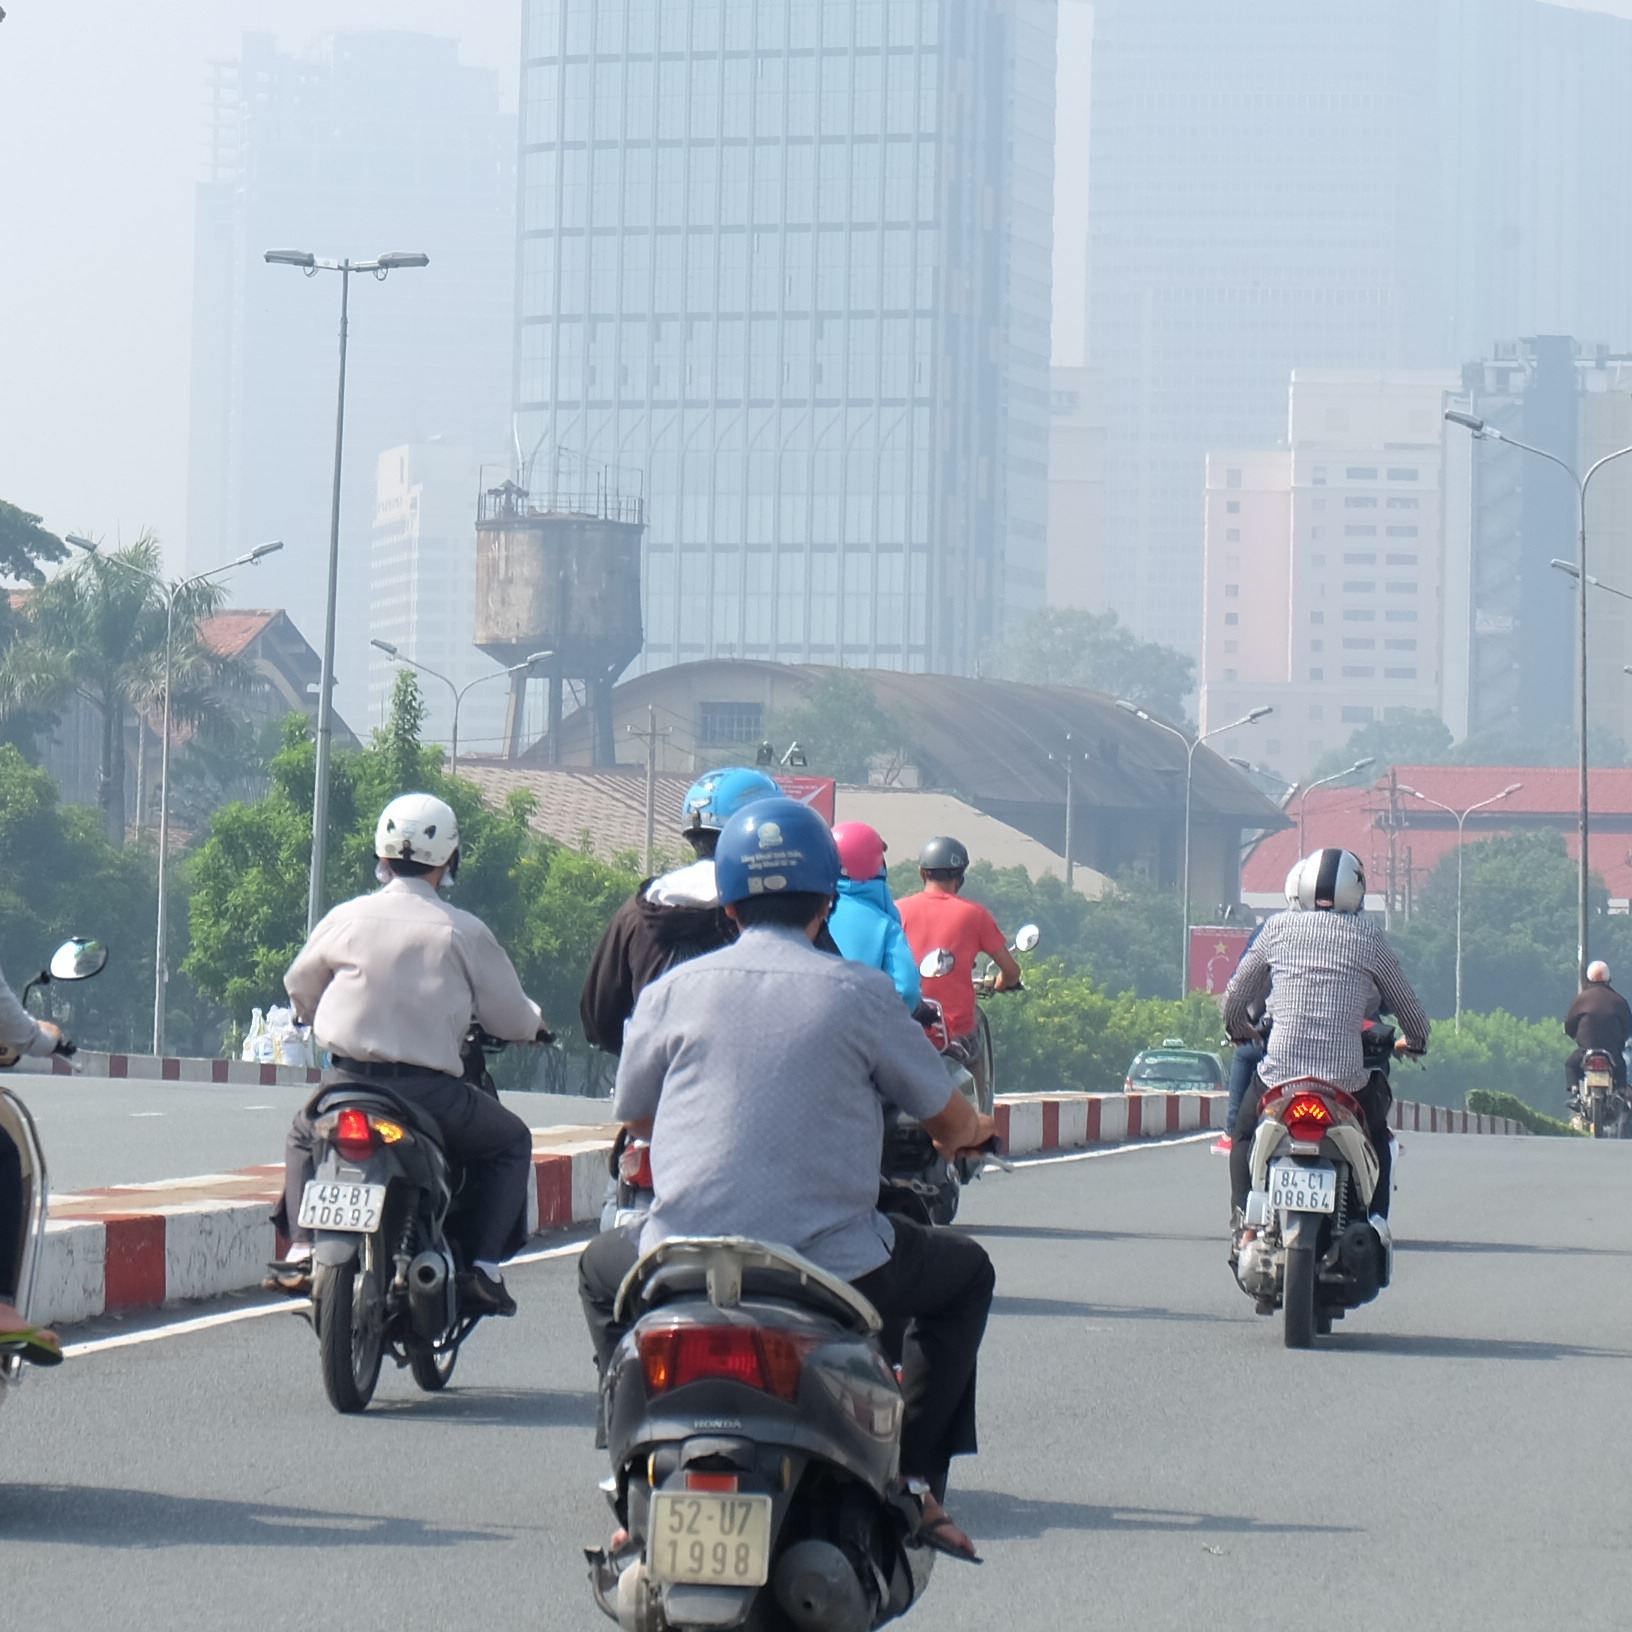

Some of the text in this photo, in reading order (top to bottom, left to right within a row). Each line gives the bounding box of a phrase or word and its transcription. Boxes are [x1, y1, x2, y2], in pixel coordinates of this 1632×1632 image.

[1281, 1171, 1324, 1190] 84-C1
[318, 1186, 371, 1206] 49-B1
[1274, 1190, 1329, 1208] 088.64
[310, 1206, 375, 1228] 106.92
[694, 1420, 742, 1429] HONDA
[669, 1500, 753, 1537] 52-U7
[667, 1539, 750, 1577] 1998
